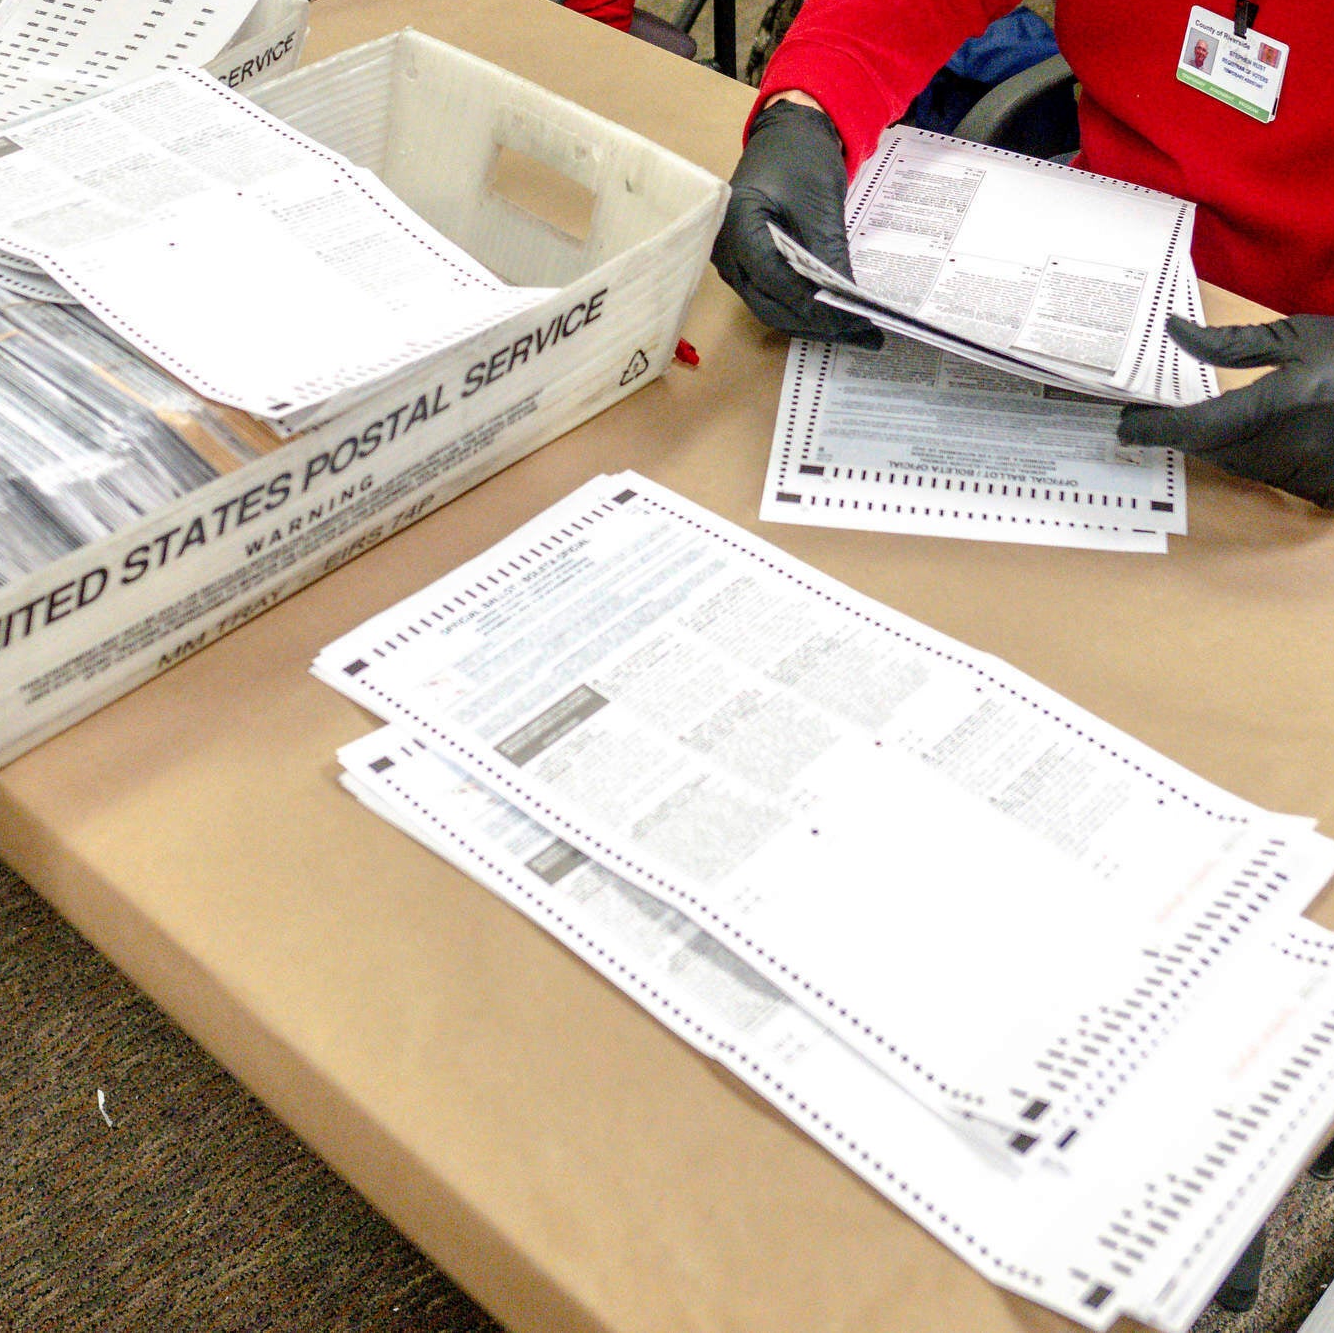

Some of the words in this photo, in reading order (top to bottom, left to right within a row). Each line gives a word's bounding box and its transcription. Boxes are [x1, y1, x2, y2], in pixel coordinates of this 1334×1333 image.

[1195, 19, 1216, 35] County
[1223, 33, 1251, 50] Riverside
[119, 471, 293, 586] STATES
[300, 384, 451, 495] POSTAL
[459, 286, 610, 400] SERVICE
[888, 460, 929, 472] OFICIAL
[931, 465, 976, 477] BOLETA
[982, 471, 1027, 483] BALLOT
[1030, 475, 1079, 488] OFFICIAL
[244, 473, 377, 559] WARNING
[324, 525, 384, 571] EIRS
